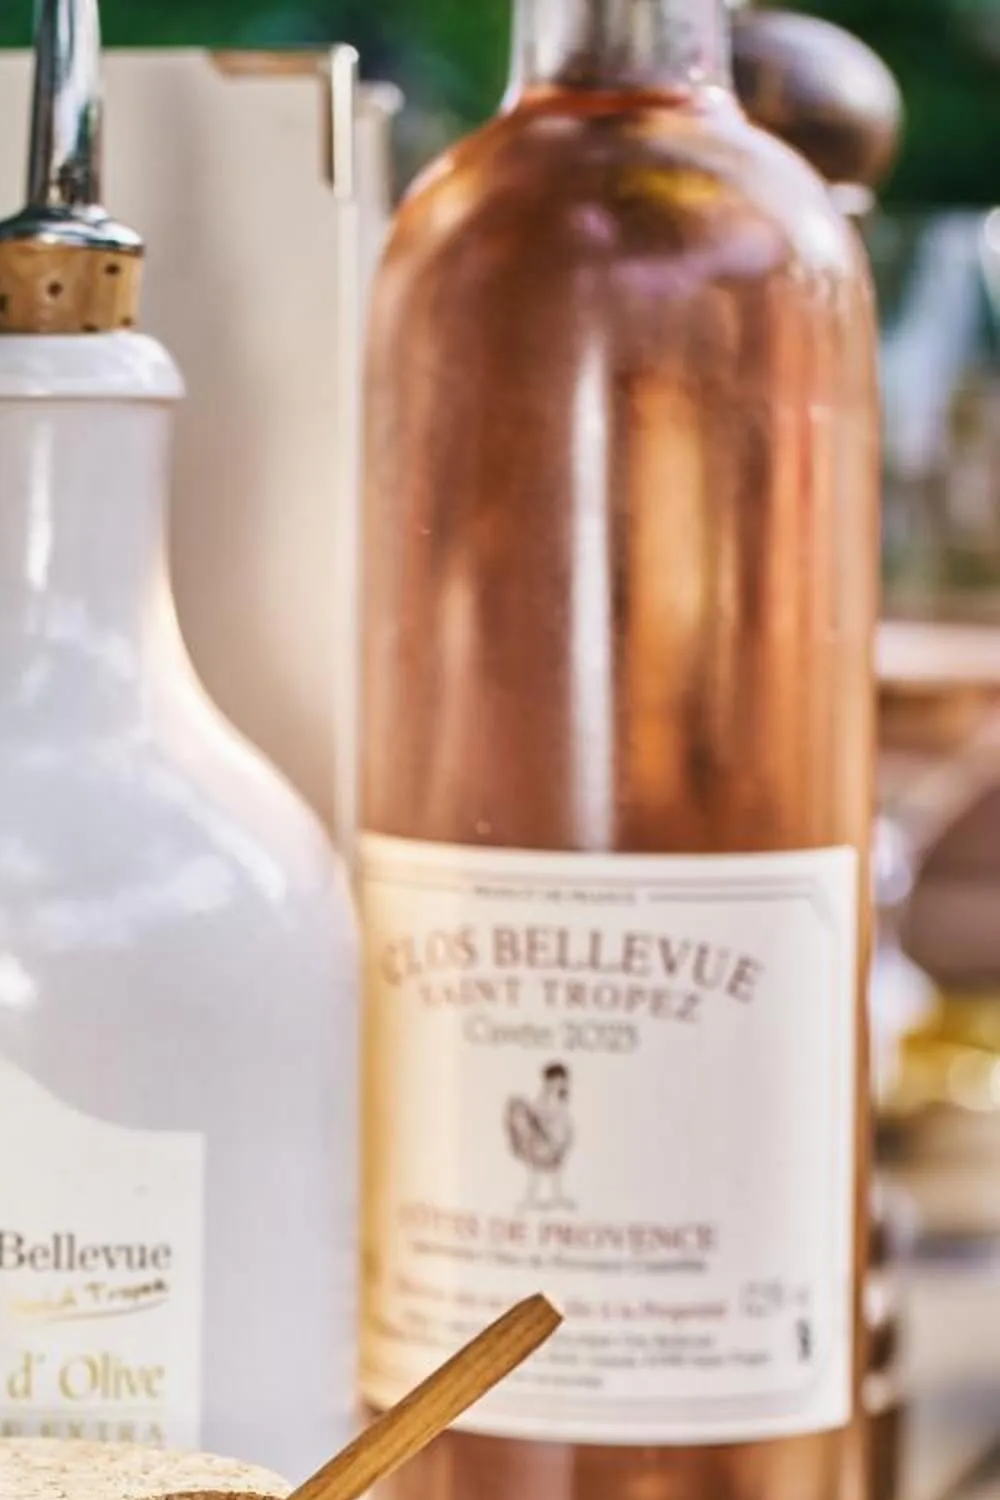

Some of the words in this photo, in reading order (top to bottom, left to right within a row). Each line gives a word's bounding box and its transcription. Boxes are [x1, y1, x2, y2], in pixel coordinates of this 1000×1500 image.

[381, 926, 477, 985] CLOS
[491, 925, 767, 1006] BELLEVUE
[419, 977, 522, 1007] SAINT
[541, 978, 703, 1024] TROPEZ
[489, 1214, 526, 1242] DE
[537, 1214, 717, 1250] PROVENCE
[58, 1350, 165, 1402] Olive
